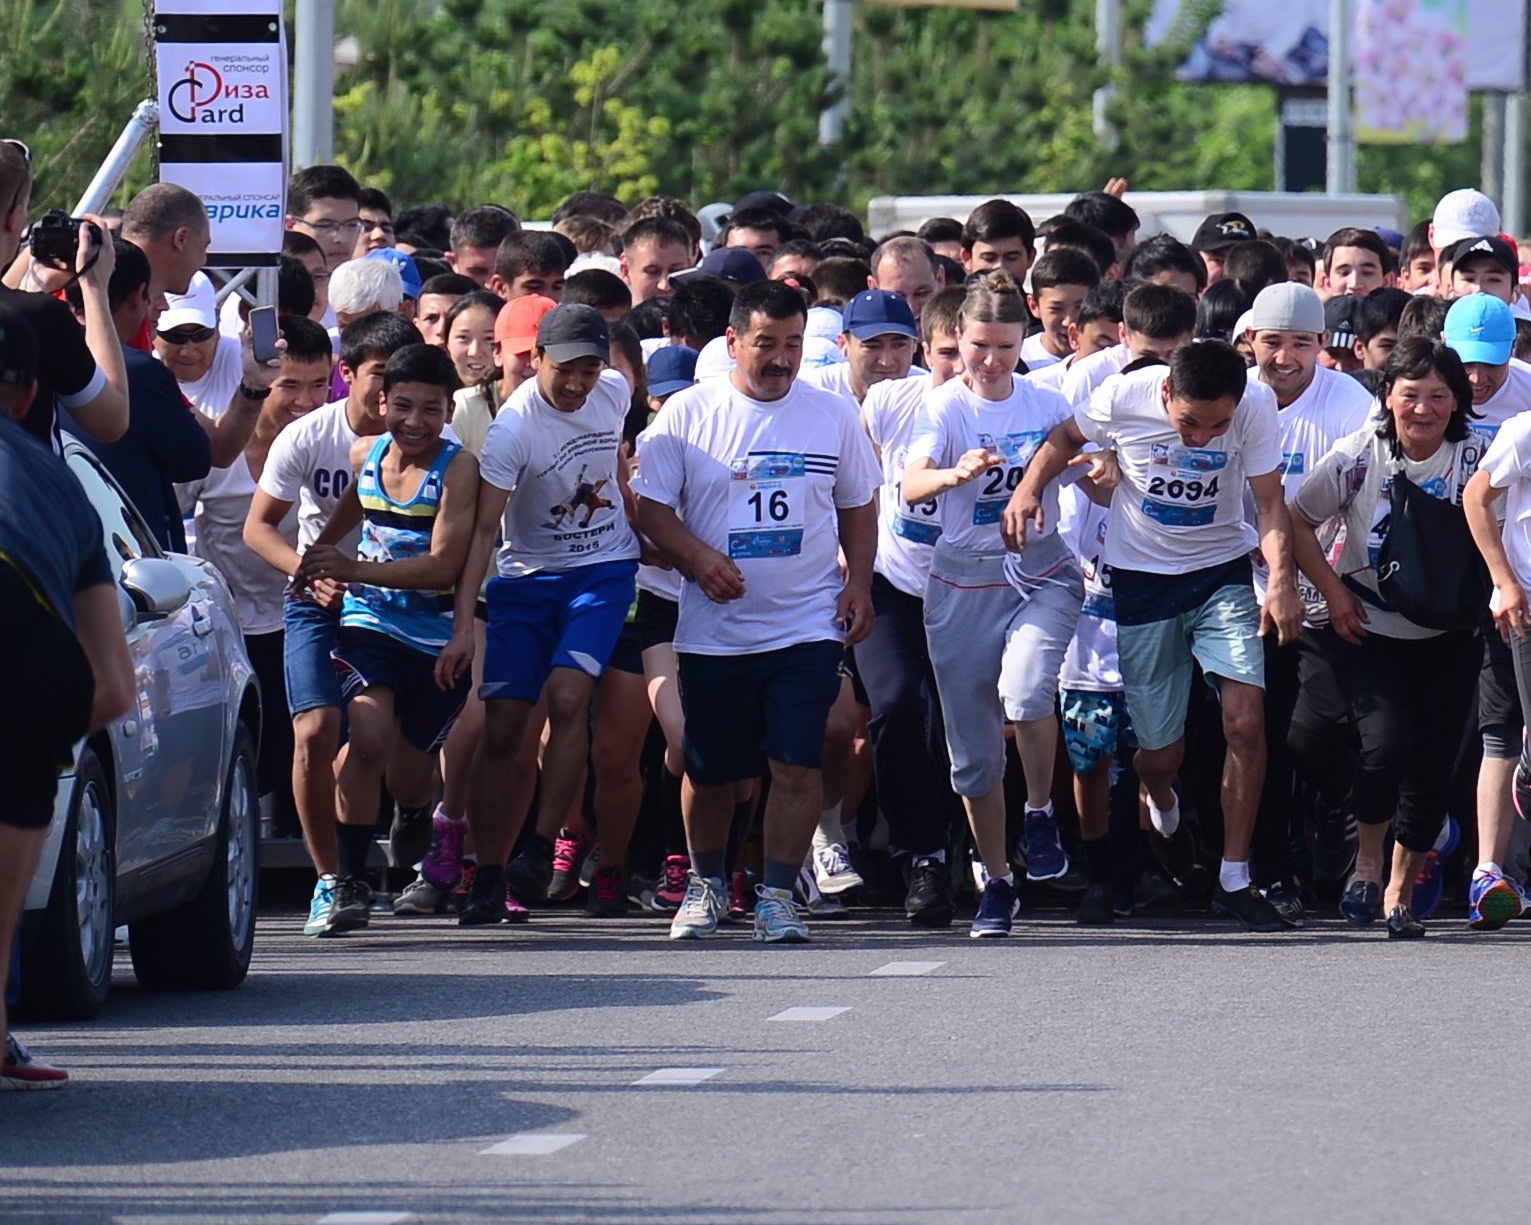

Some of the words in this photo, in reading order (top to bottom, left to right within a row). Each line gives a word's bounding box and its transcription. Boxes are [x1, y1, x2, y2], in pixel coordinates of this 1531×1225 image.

[223, 63, 270, 74] спонсор
[1147, 475, 1220, 501] 2694
[747, 489, 790, 523] 16
